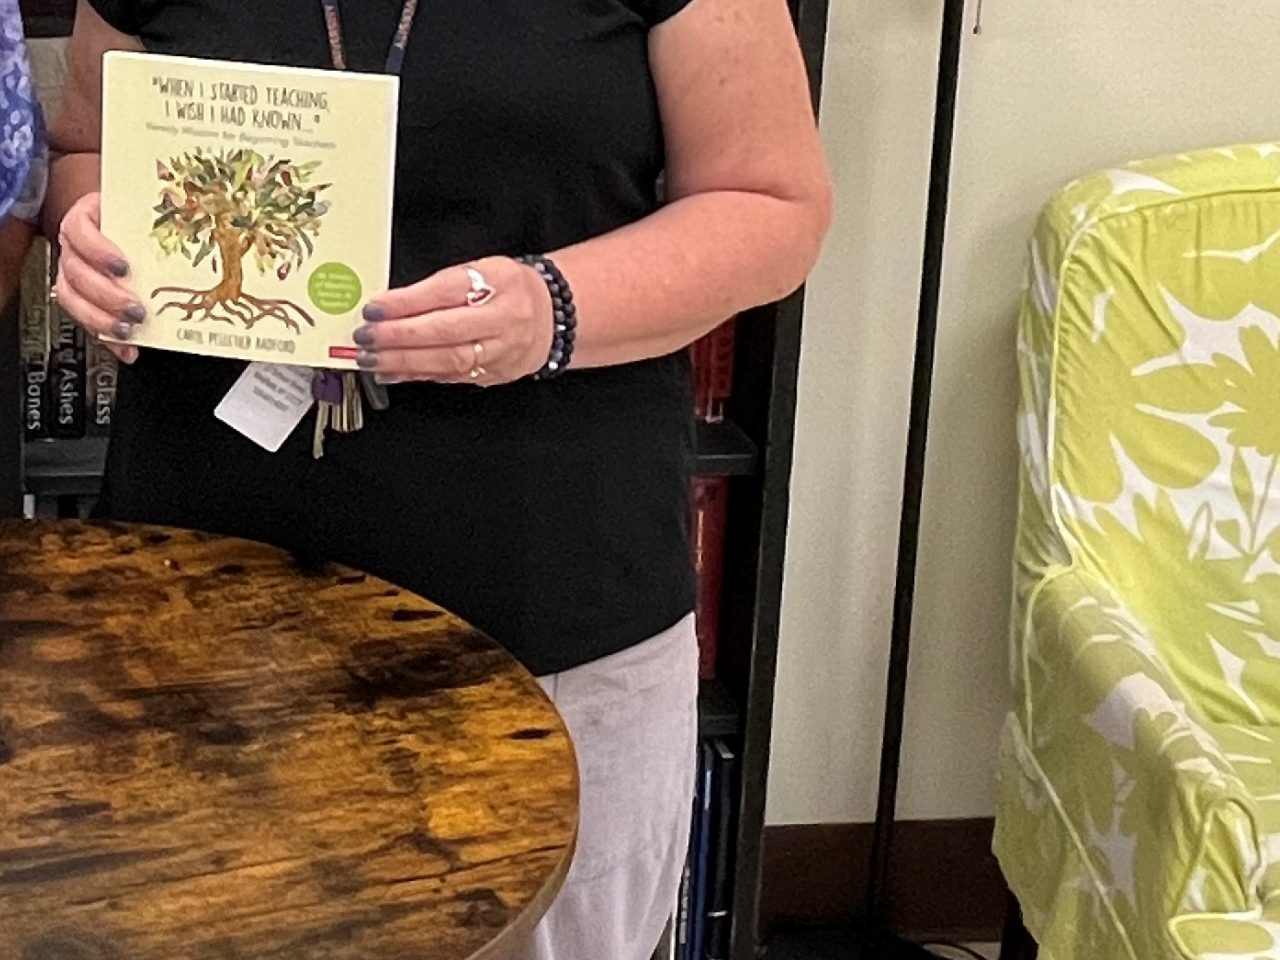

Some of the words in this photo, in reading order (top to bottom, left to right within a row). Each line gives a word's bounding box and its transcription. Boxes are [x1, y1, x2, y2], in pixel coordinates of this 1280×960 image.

[165, 100, 170, 118] I
[176, 101, 204, 121] WISH
[210, 106, 215, 123] I
[220, 106, 247, 127] HAD
[200, 82, 204, 97] I
[211, 81, 258, 106] STARTED
[27, 369, 48, 431] Bones
[59, 367, 81, 426] Ashes
[96, 370, 117, 426] Glass
